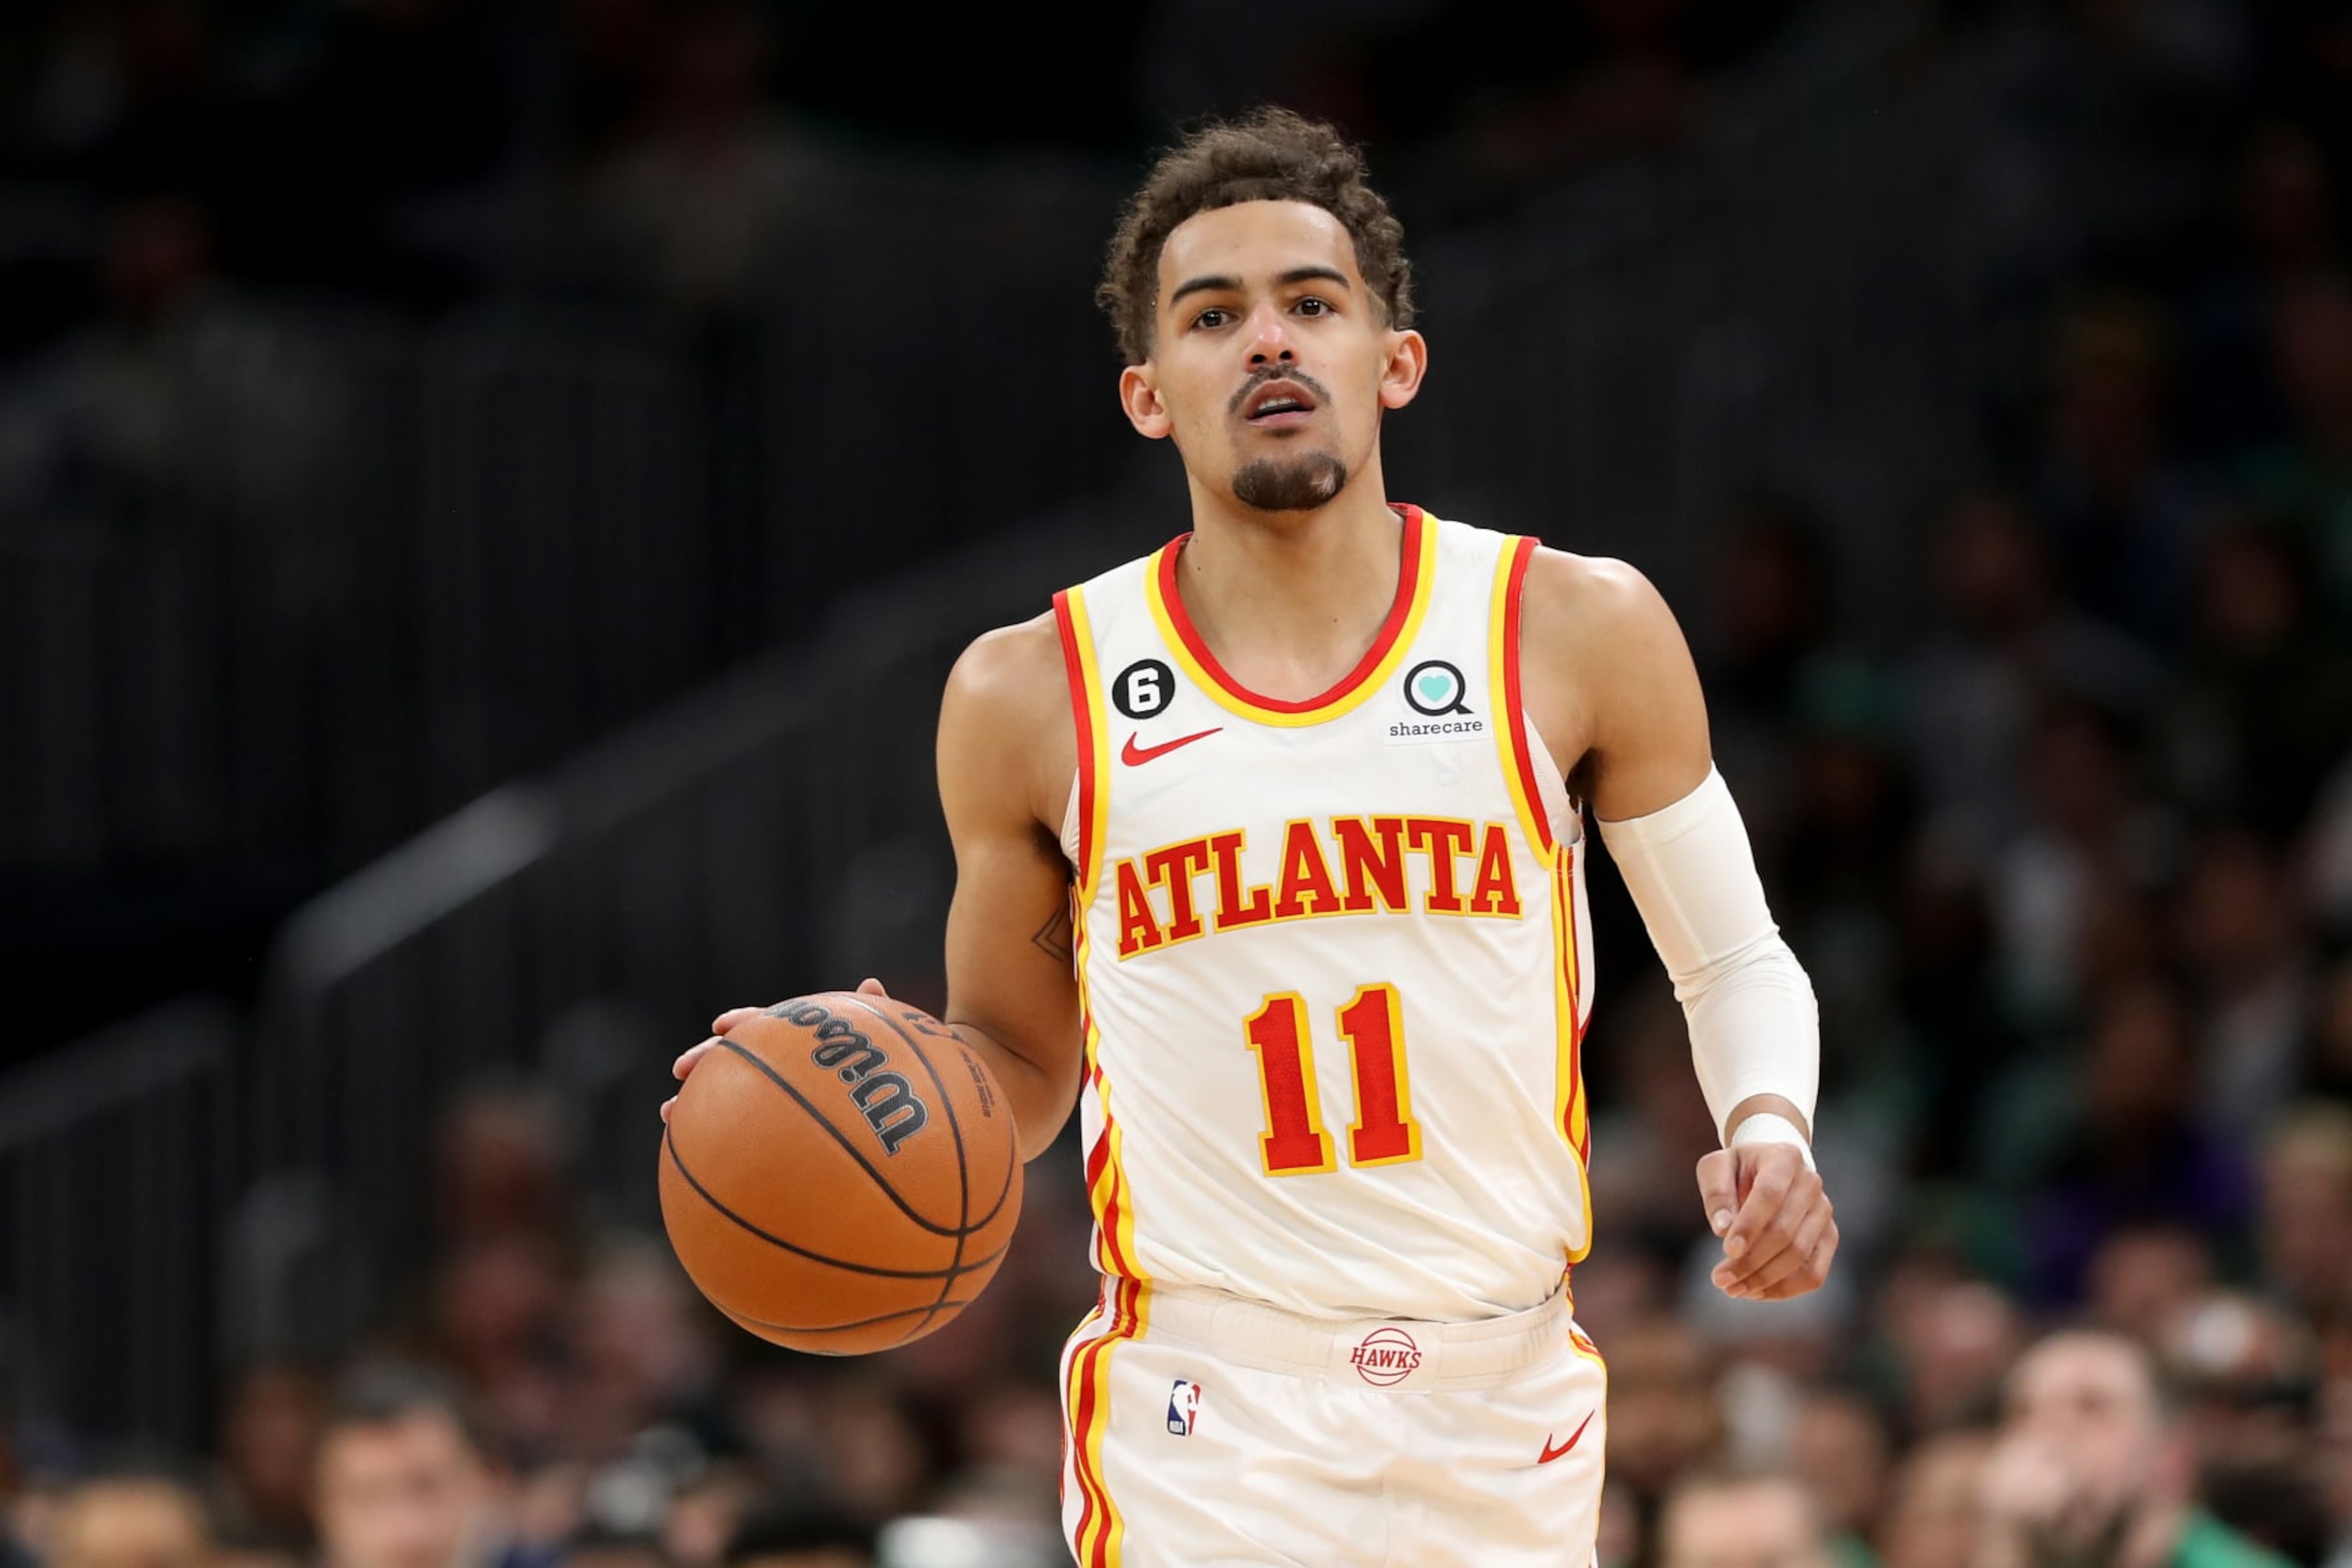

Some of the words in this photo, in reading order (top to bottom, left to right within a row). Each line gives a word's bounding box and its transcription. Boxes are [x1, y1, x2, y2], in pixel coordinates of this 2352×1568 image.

[1128, 667, 1161, 713] 6
[1390, 721, 1482, 736] sharecare
[1115, 814, 1521, 961] ATLANTA
[1242, 981, 1423, 1177] 11
[1350, 1347, 1422, 1369] HAWKS
